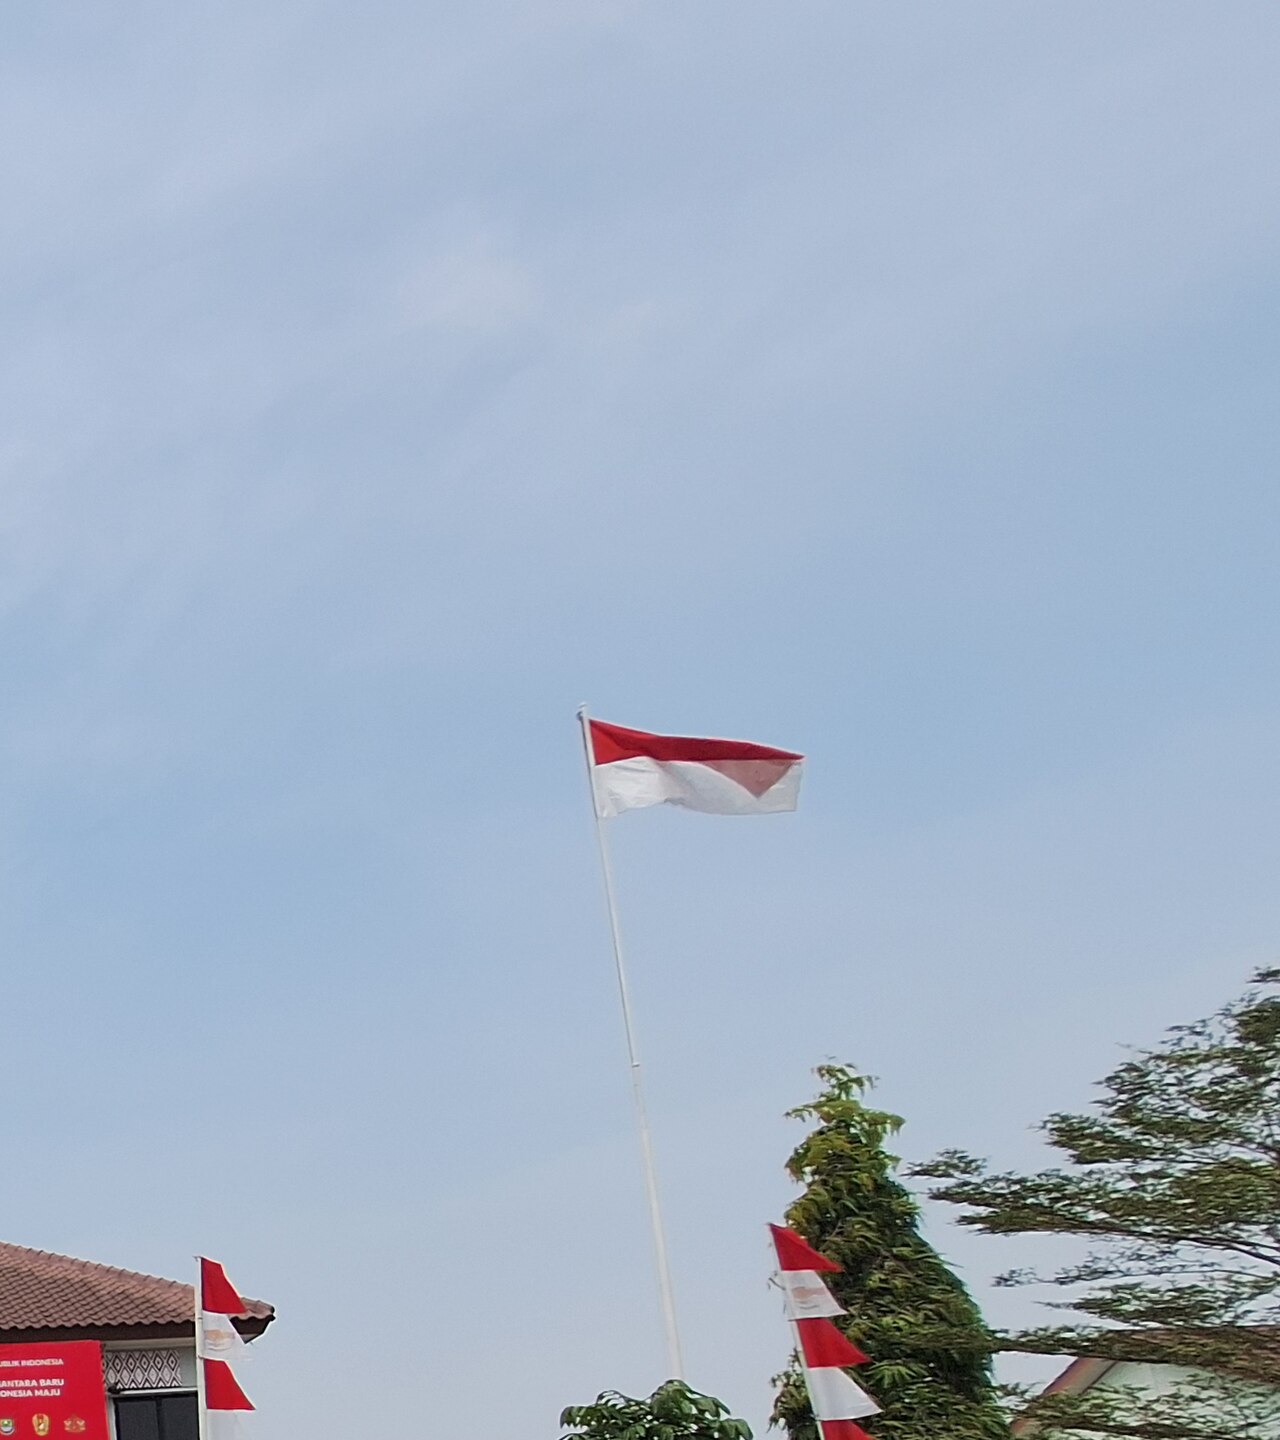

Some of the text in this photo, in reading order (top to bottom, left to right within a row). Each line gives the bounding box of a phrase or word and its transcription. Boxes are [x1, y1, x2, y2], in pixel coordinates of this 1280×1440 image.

[21, 1358, 64, 1367] INDONESIA
[39, 1378, 65, 1387] BARU
[34, 1388, 61, 1397] MAJU
